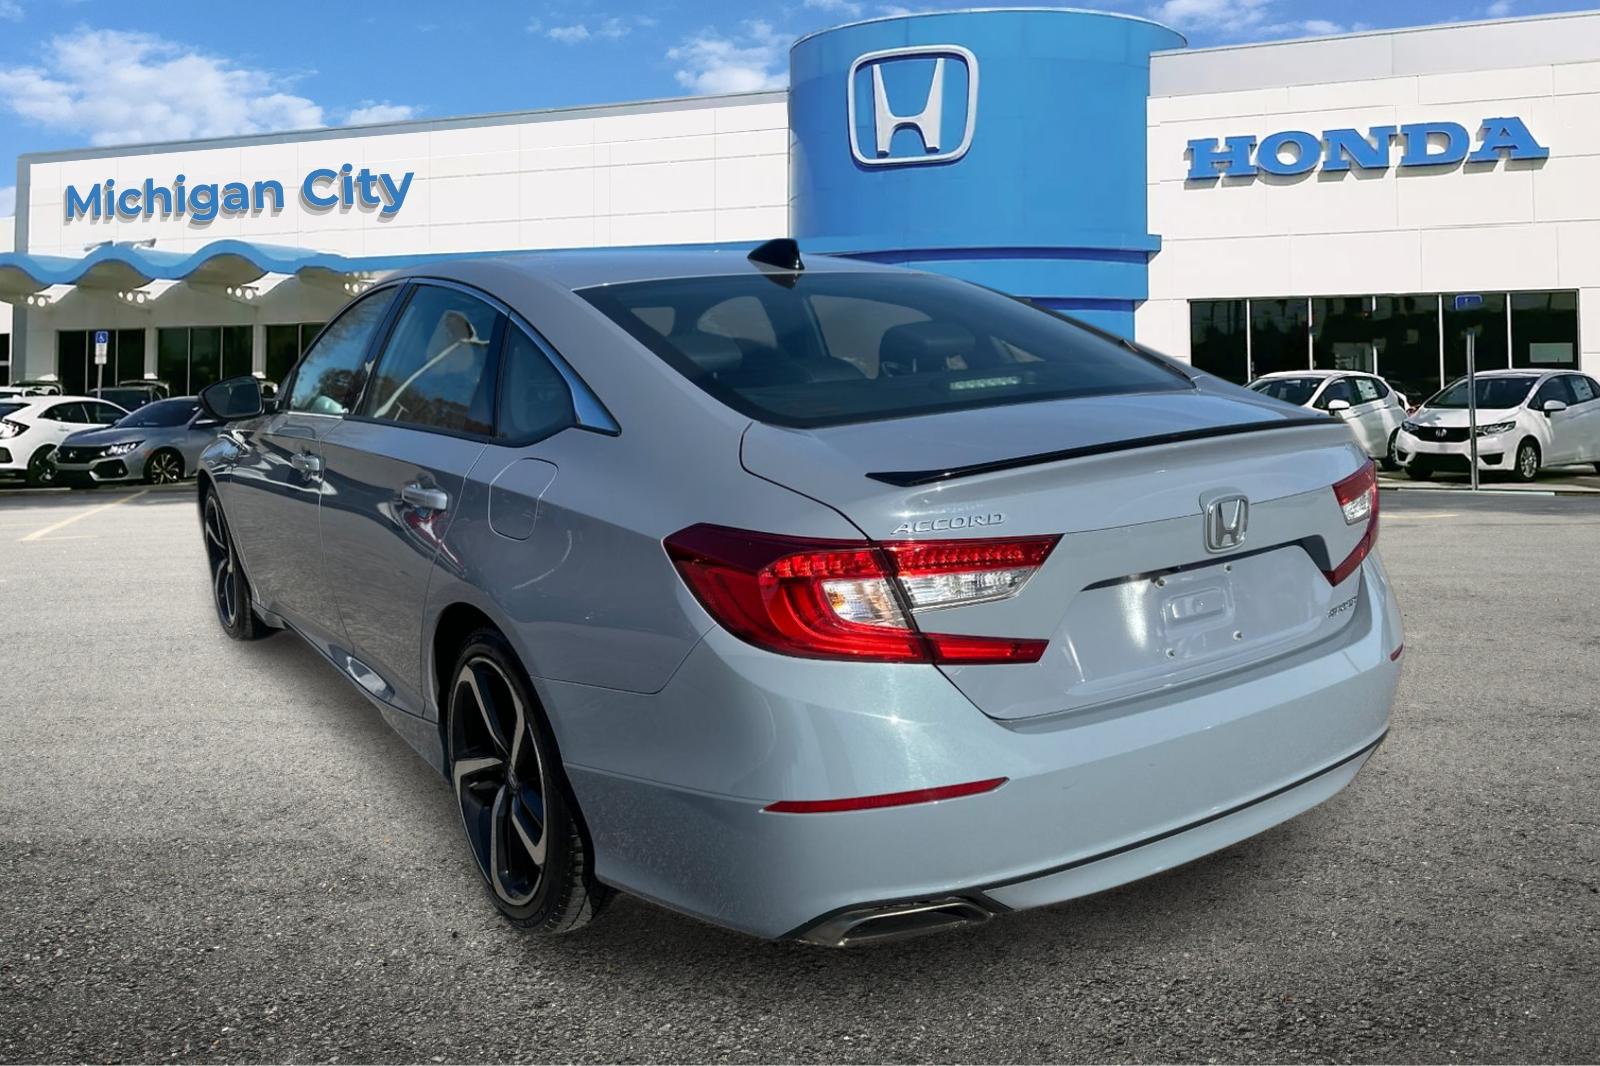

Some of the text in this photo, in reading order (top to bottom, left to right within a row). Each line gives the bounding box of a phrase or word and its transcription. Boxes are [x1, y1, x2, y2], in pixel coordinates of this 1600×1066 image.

[1186, 116, 1550, 182] HONDA
[66, 163, 415, 223] Michigan City
[890, 513, 1006, 535] ACCORD
